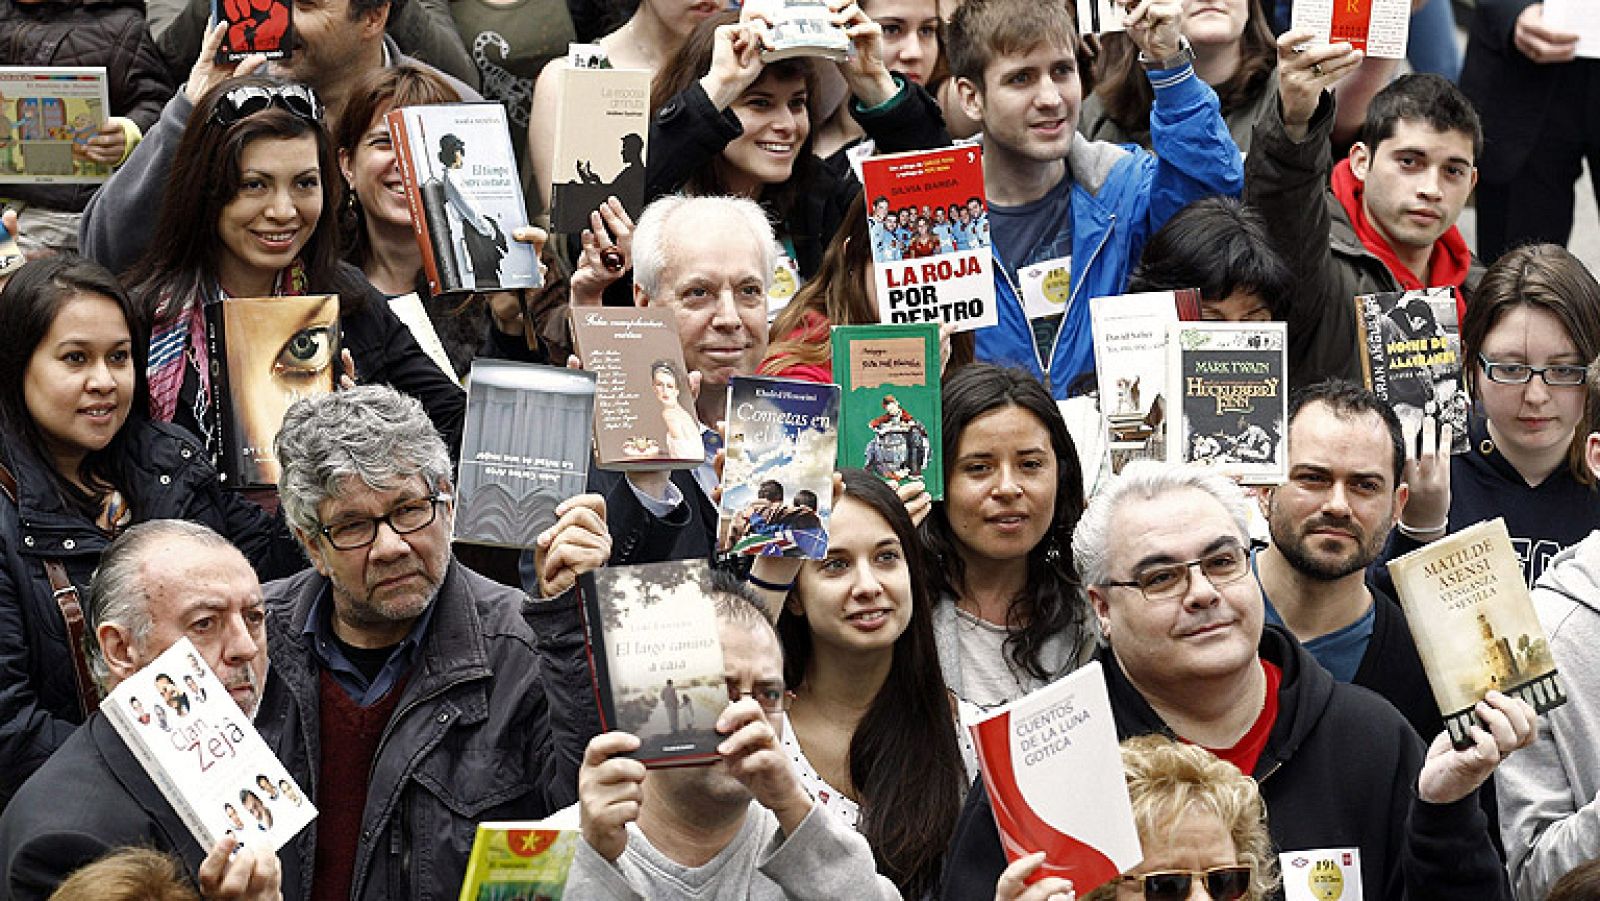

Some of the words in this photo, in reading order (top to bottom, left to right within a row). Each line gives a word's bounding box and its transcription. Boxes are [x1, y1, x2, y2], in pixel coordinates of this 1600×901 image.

[891, 185, 922, 197] SILVIA
[924, 178, 959, 191] BARBA
[885, 266, 919, 288] LA
[920, 256, 982, 285] ROJA
[889, 285, 939, 309] POR
[891, 297, 984, 324] DENTRO
[1387, 339, 1428, 355] NOCHE
[1430, 337, 1447, 349] DE
[1195, 360, 1230, 374] MARK
[1230, 360, 1270, 374] TWAIN
[755, 389, 781, 399] Khaled
[1185, 376, 1280, 397] HUCKLEBERRY
[737, 402, 808, 426] Cometas
[811, 416, 830, 429] en
[1216, 394, 1250, 416] FINN
[508, 469, 536, 481] Carlos
[539, 472, 561, 483] Juan
[1424, 538, 1495, 579] MATILDE
[1439, 558, 1491, 591] ASENSI
[1440, 574, 1499, 602] VENGANZA
[616, 641, 630, 657] El
[634, 640, 666, 656] largo
[668, 637, 716, 652] camino
[648, 661, 657, 672] a
[660, 659, 687, 671] casa
[1016, 701, 1074, 737] CUENTOS
[1021, 735, 1038, 752] DE
[1041, 727, 1057, 743] LA
[1059, 709, 1091, 733] LUNA
[170, 718, 209, 751] Clan
